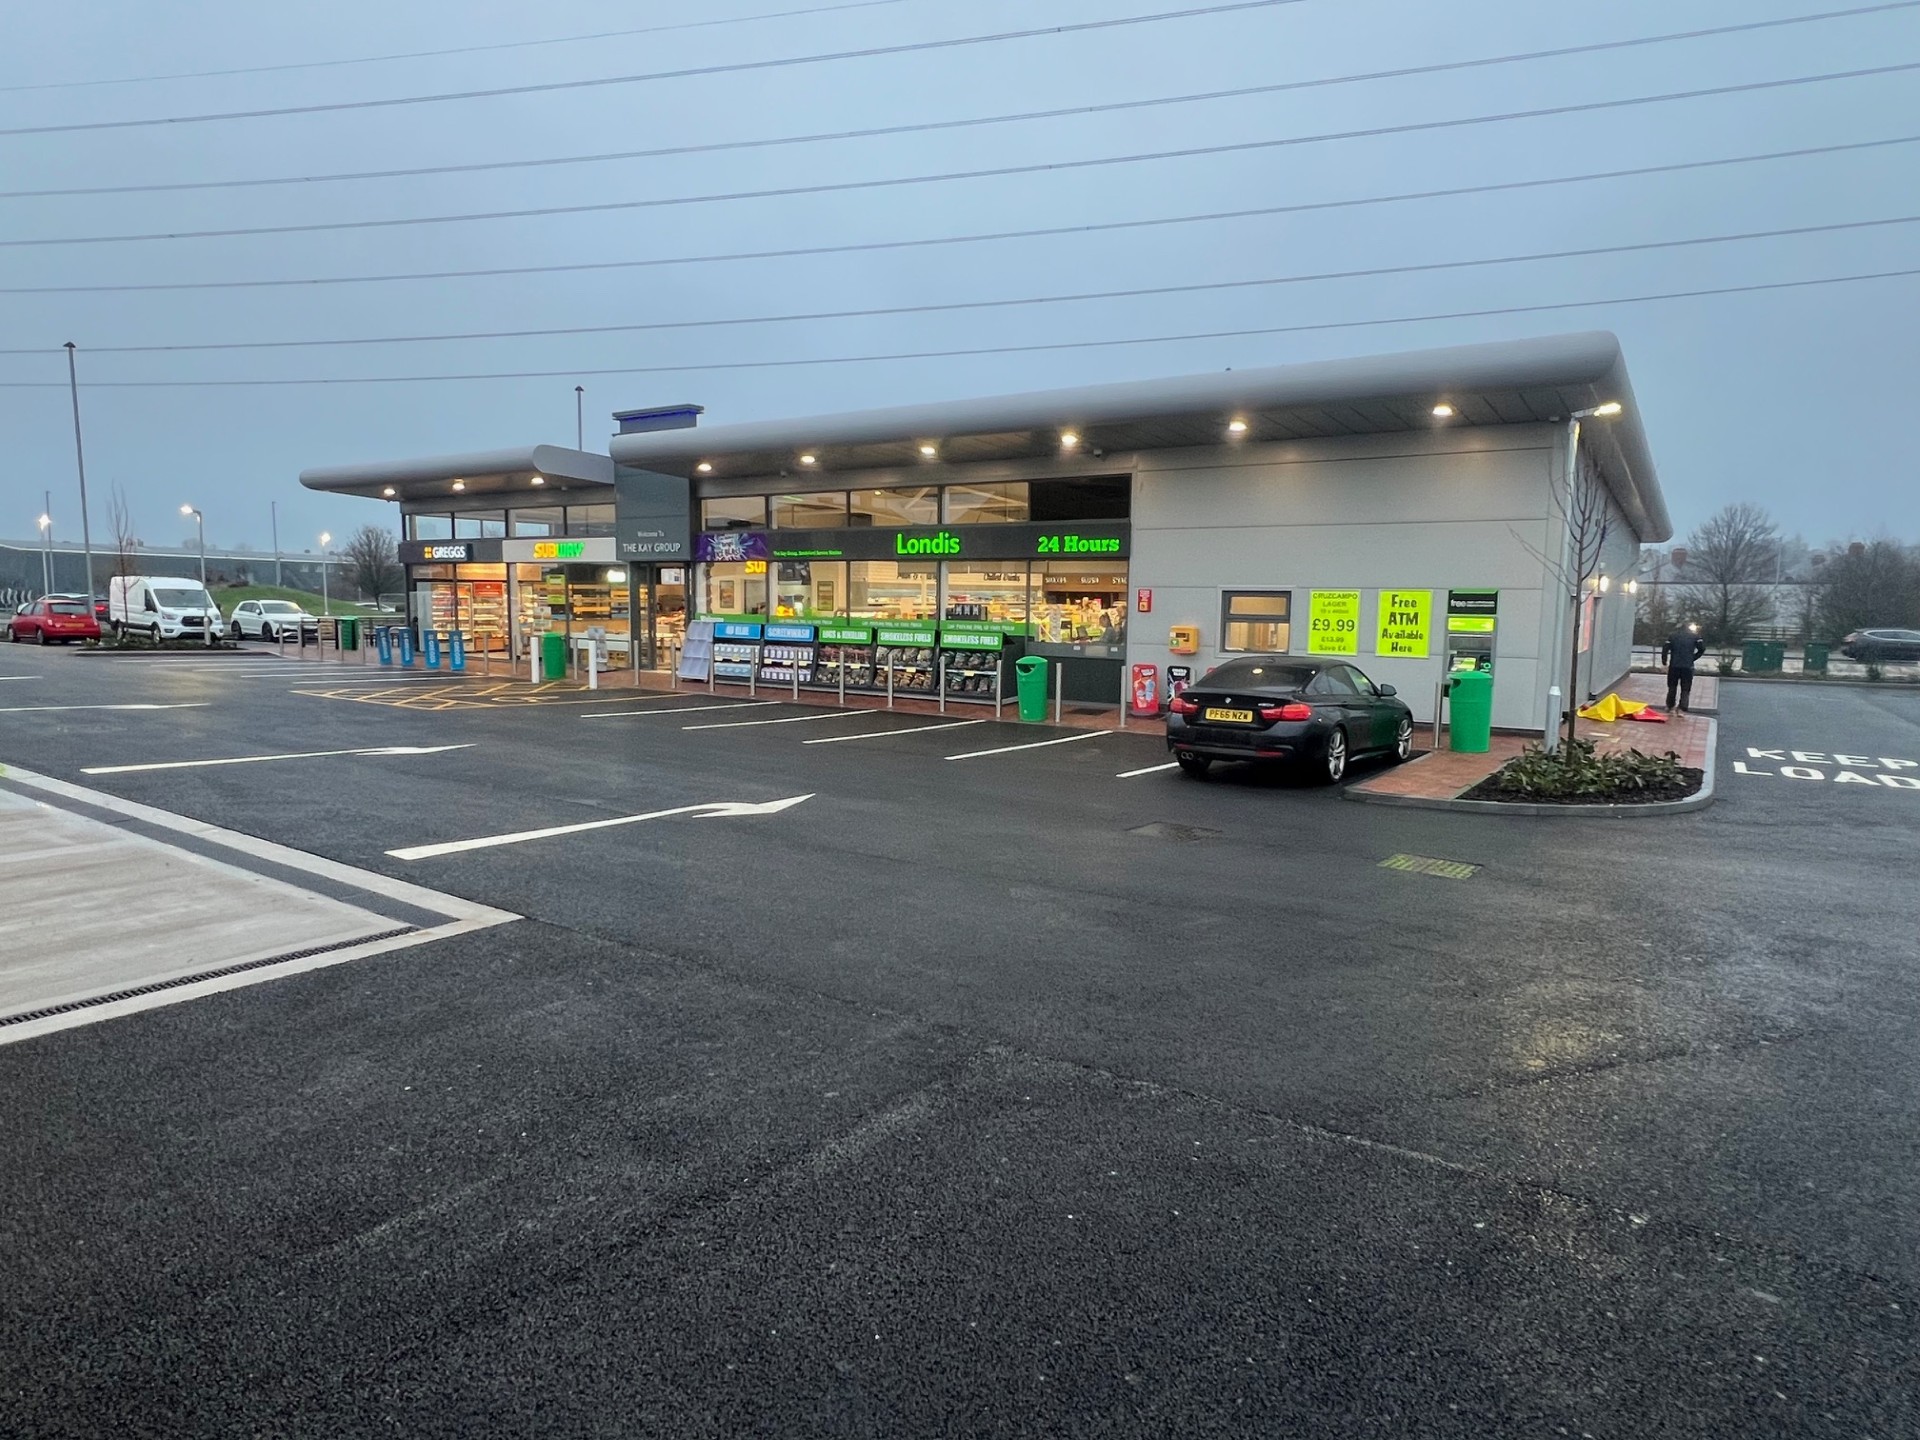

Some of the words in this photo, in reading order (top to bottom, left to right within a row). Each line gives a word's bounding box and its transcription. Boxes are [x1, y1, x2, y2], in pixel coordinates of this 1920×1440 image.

[623, 543, 637, 552] THE
[638, 543, 653, 552] KAY
[654, 542, 681, 552] GROUP
[897, 532, 960, 554] Londis
[1038, 536, 1060, 552] 24
[1063, 536, 1120, 552] Hours
[432, 546, 466, 559] GREGGS
[533, 542, 584, 558] SUBWAY
[1391, 594, 1417, 608] Free
[1388, 612, 1419, 625] ATM
[1312, 619, 1355, 632] £9.99
[880, 632, 913, 642] SMOKELESS
[914, 633, 932, 643] FUELS
[943, 635, 979, 645] SMOKELESS
[979, 636, 999, 646] FUELS
[1382, 628, 1424, 640] Available
[1391, 642, 1412, 652] Here
[1231, 711, 1249, 720] NZW
[1747, 747, 1919, 769] KEEP
[1733, 761, 1920, 790] LOAD
